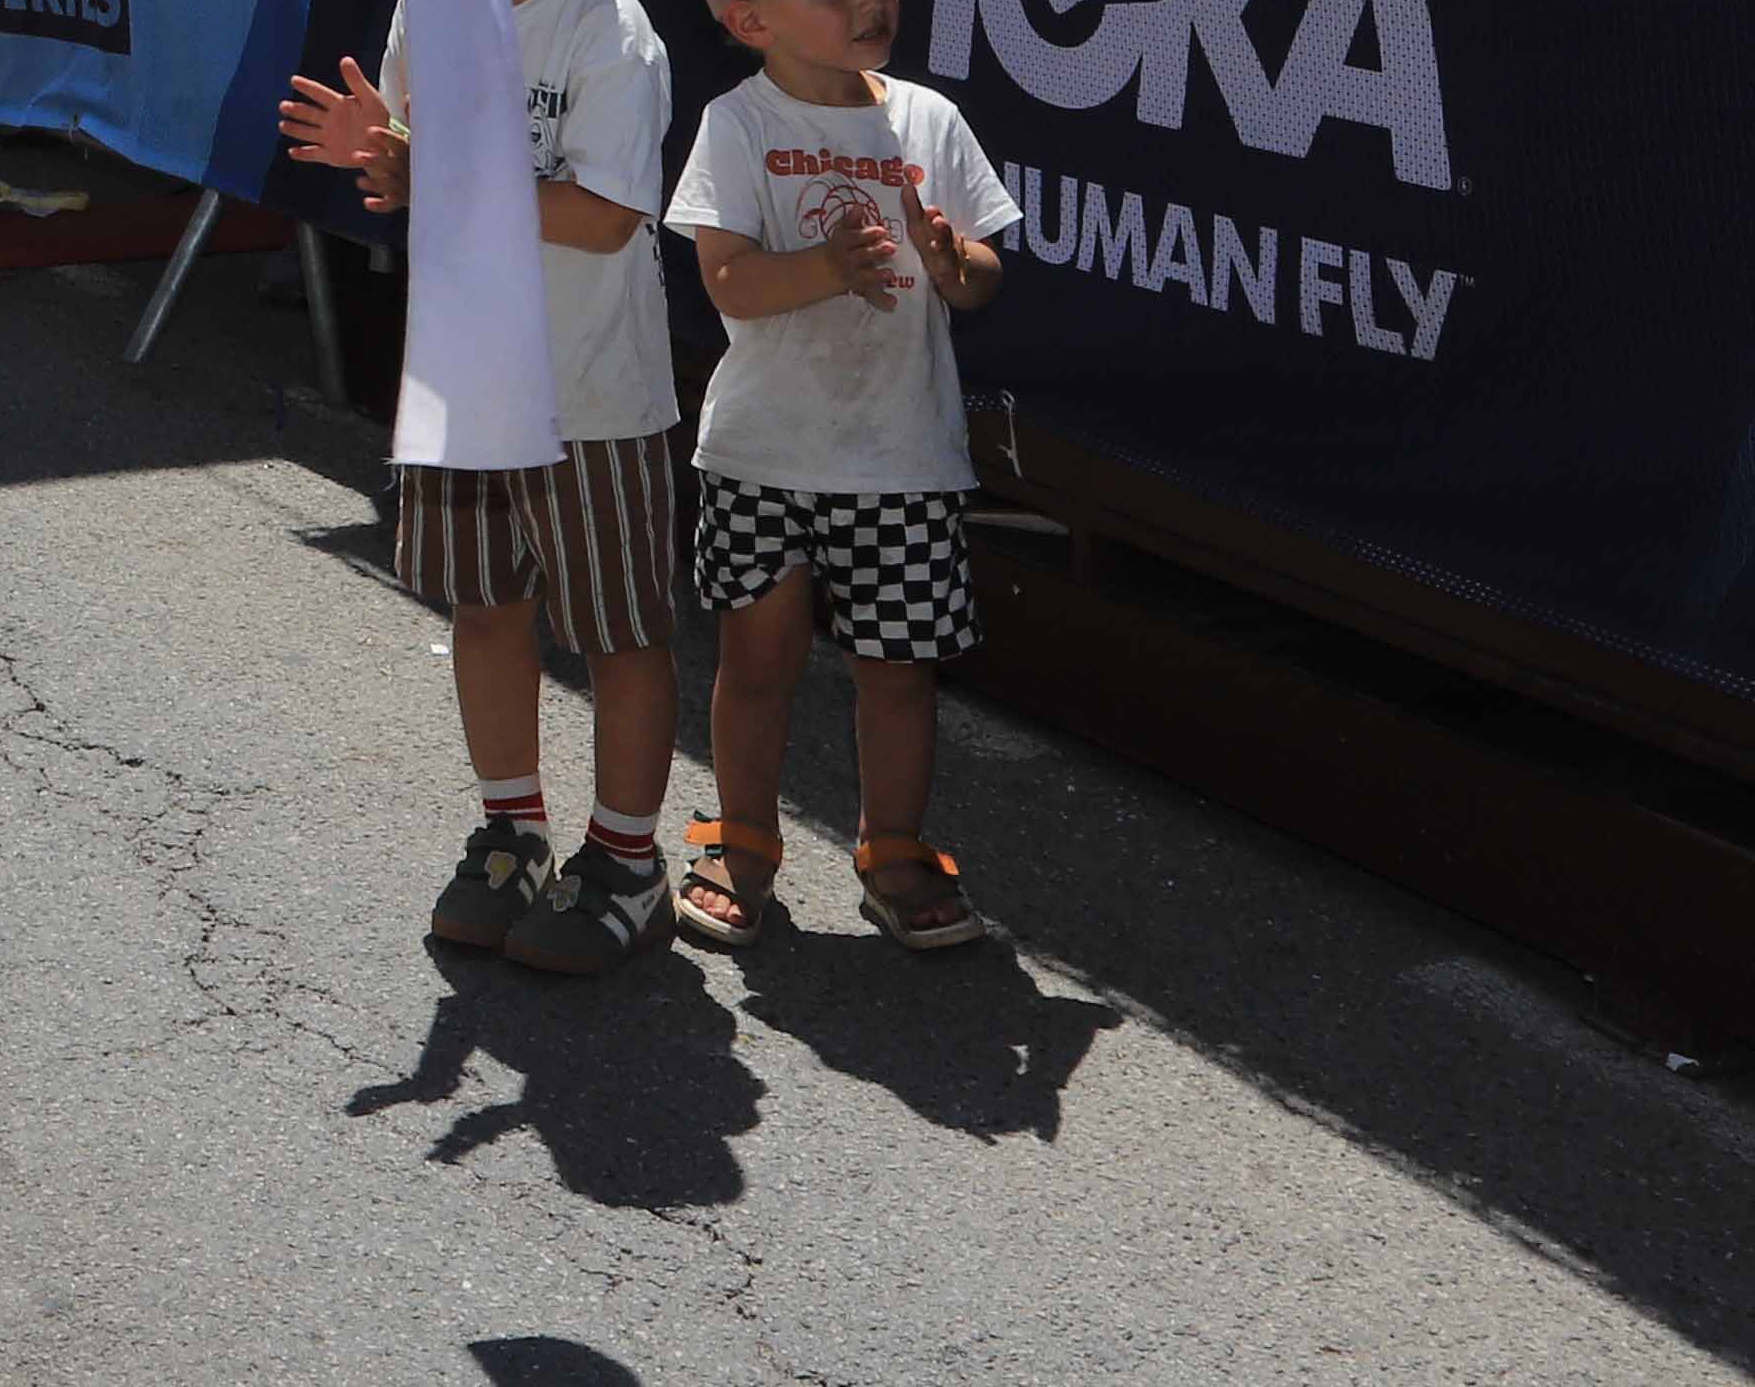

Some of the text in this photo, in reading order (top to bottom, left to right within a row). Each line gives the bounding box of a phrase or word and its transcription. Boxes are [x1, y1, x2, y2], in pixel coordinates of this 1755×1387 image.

[766, 148, 925, 189] Chicago
[1004, 162, 1458, 361] HUMAN FLY
